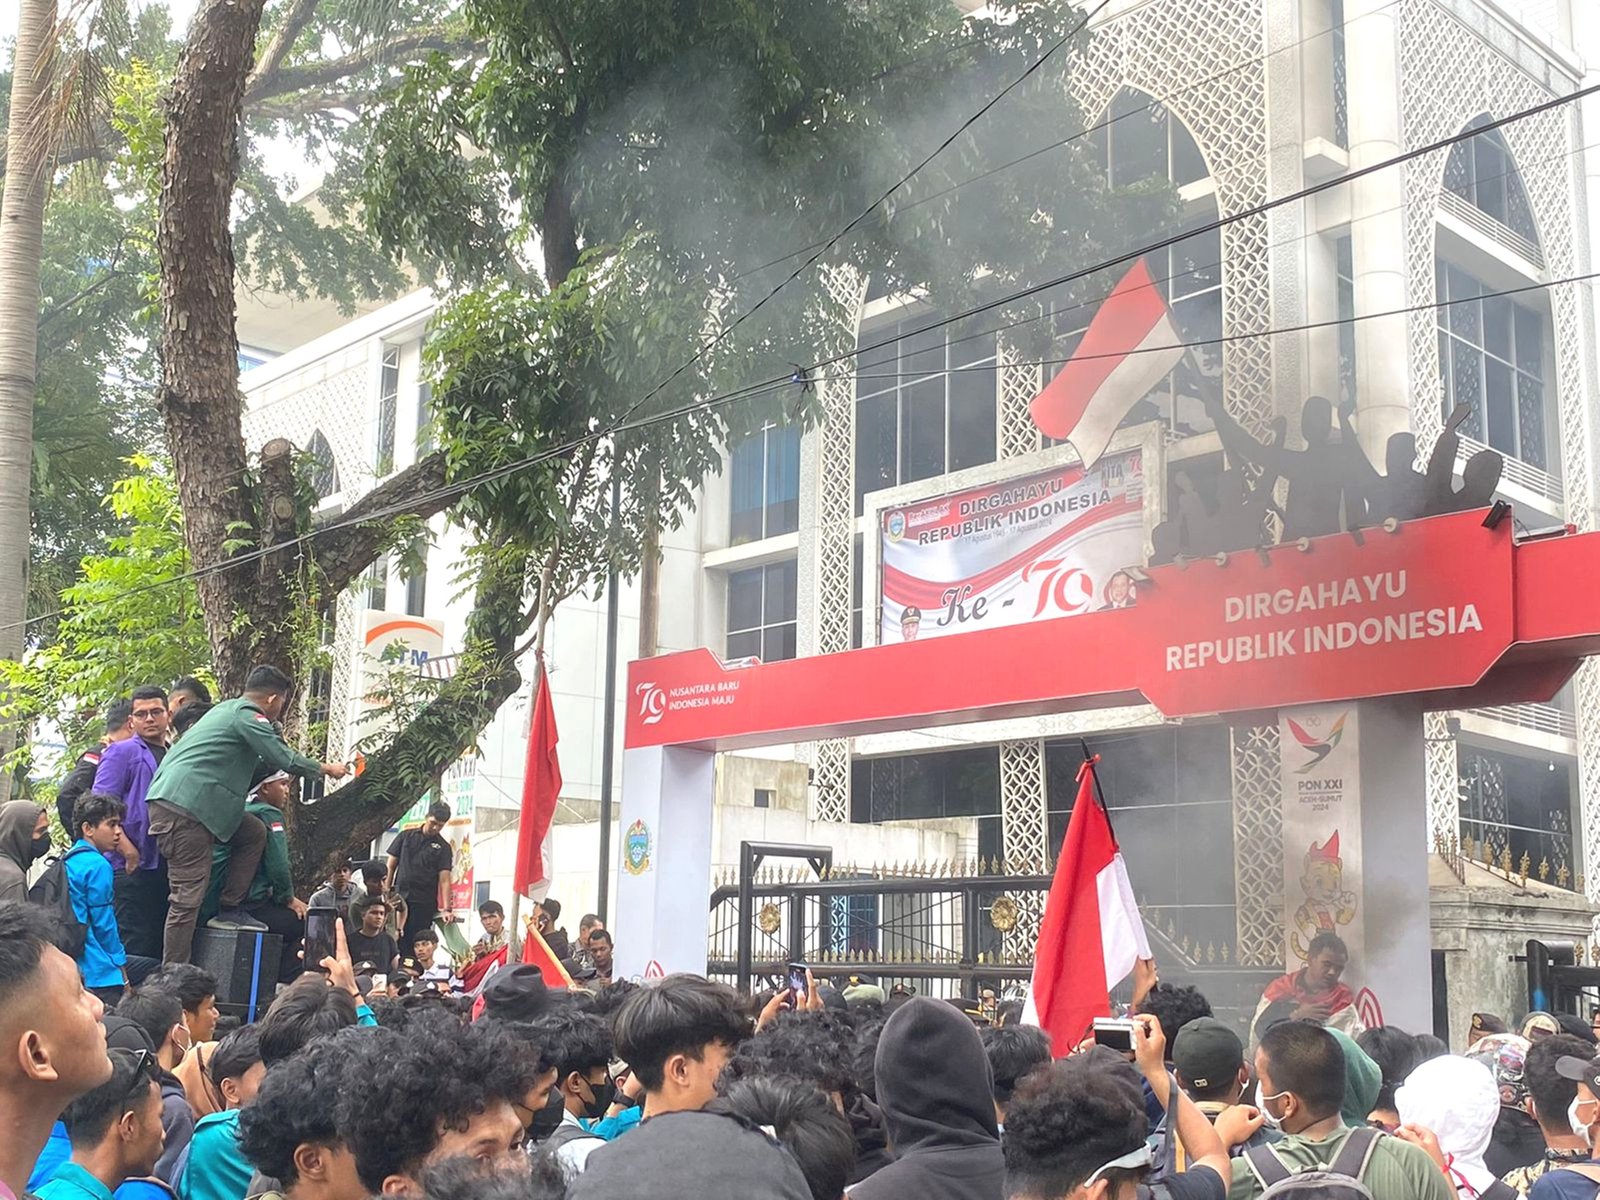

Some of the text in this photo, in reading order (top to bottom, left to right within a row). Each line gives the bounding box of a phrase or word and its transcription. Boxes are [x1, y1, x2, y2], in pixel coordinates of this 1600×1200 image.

[960, 479, 1063, 516] DIRGAHAYU
[919, 515, 1002, 546] REPUBLIK
[1008, 490, 1111, 526] INDONESIA
[937, 584, 988, 626] Ke
[1225, 570, 1407, 623] DIRGAHAYU
[1166, 604, 1483, 672] REPUBLIK INDONESIA
[635, 681, 666, 725] 79
[669, 680, 740, 697] NUSANTARA BARU
[669, 695, 735, 711] INDONESIA MAJU
[1298, 778, 1343, 791] PON XXI
[456, 795, 474, 816] 2024
[1311, 803, 1329, 811] 2024
